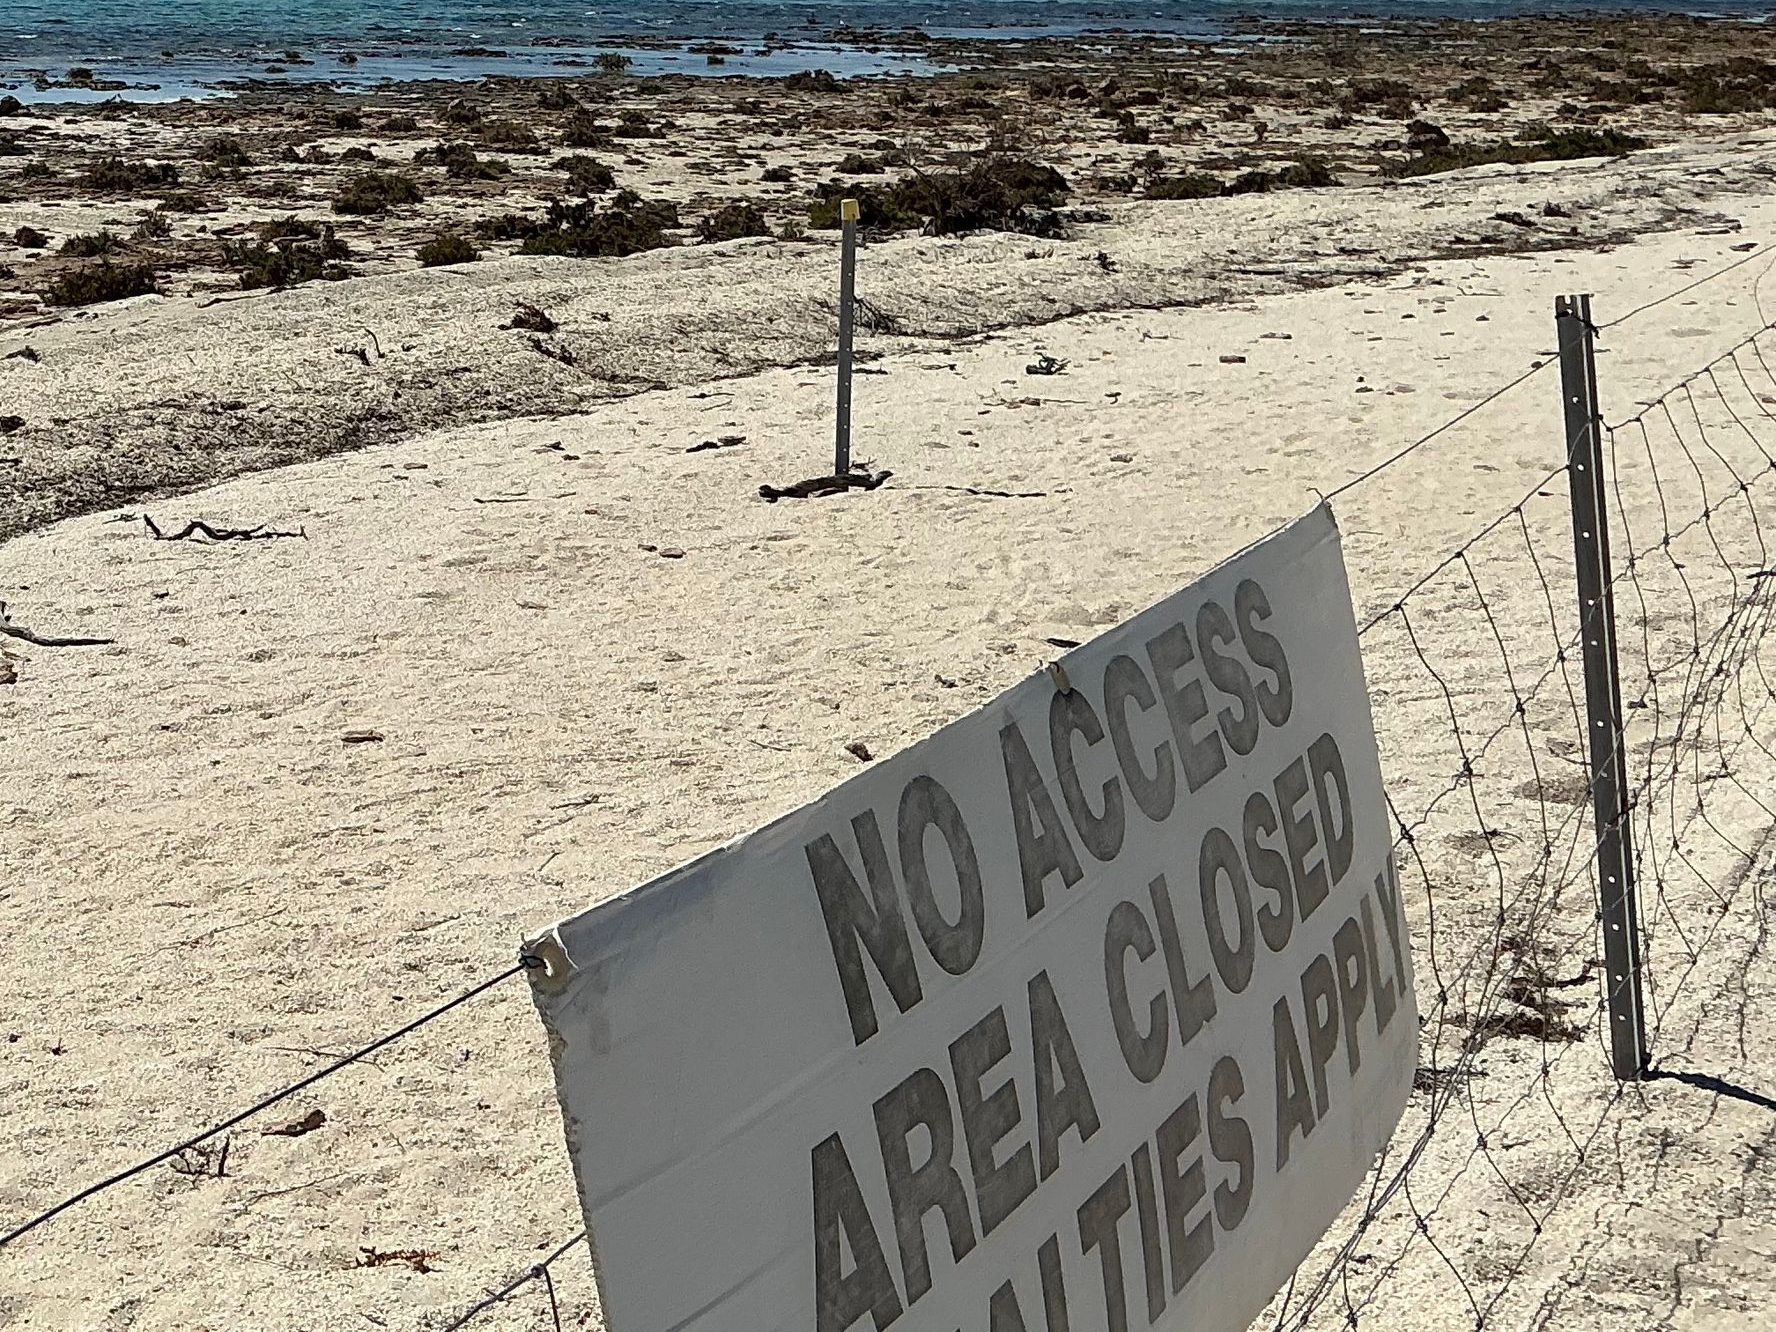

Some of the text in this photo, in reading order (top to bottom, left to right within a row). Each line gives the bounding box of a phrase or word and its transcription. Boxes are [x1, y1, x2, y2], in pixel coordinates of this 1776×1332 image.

[805, 579, 1293, 1046] NO ACCESS
[811, 732, 1354, 1332] AREA CLOSED
[1273, 850, 1407, 1172] APPLY
